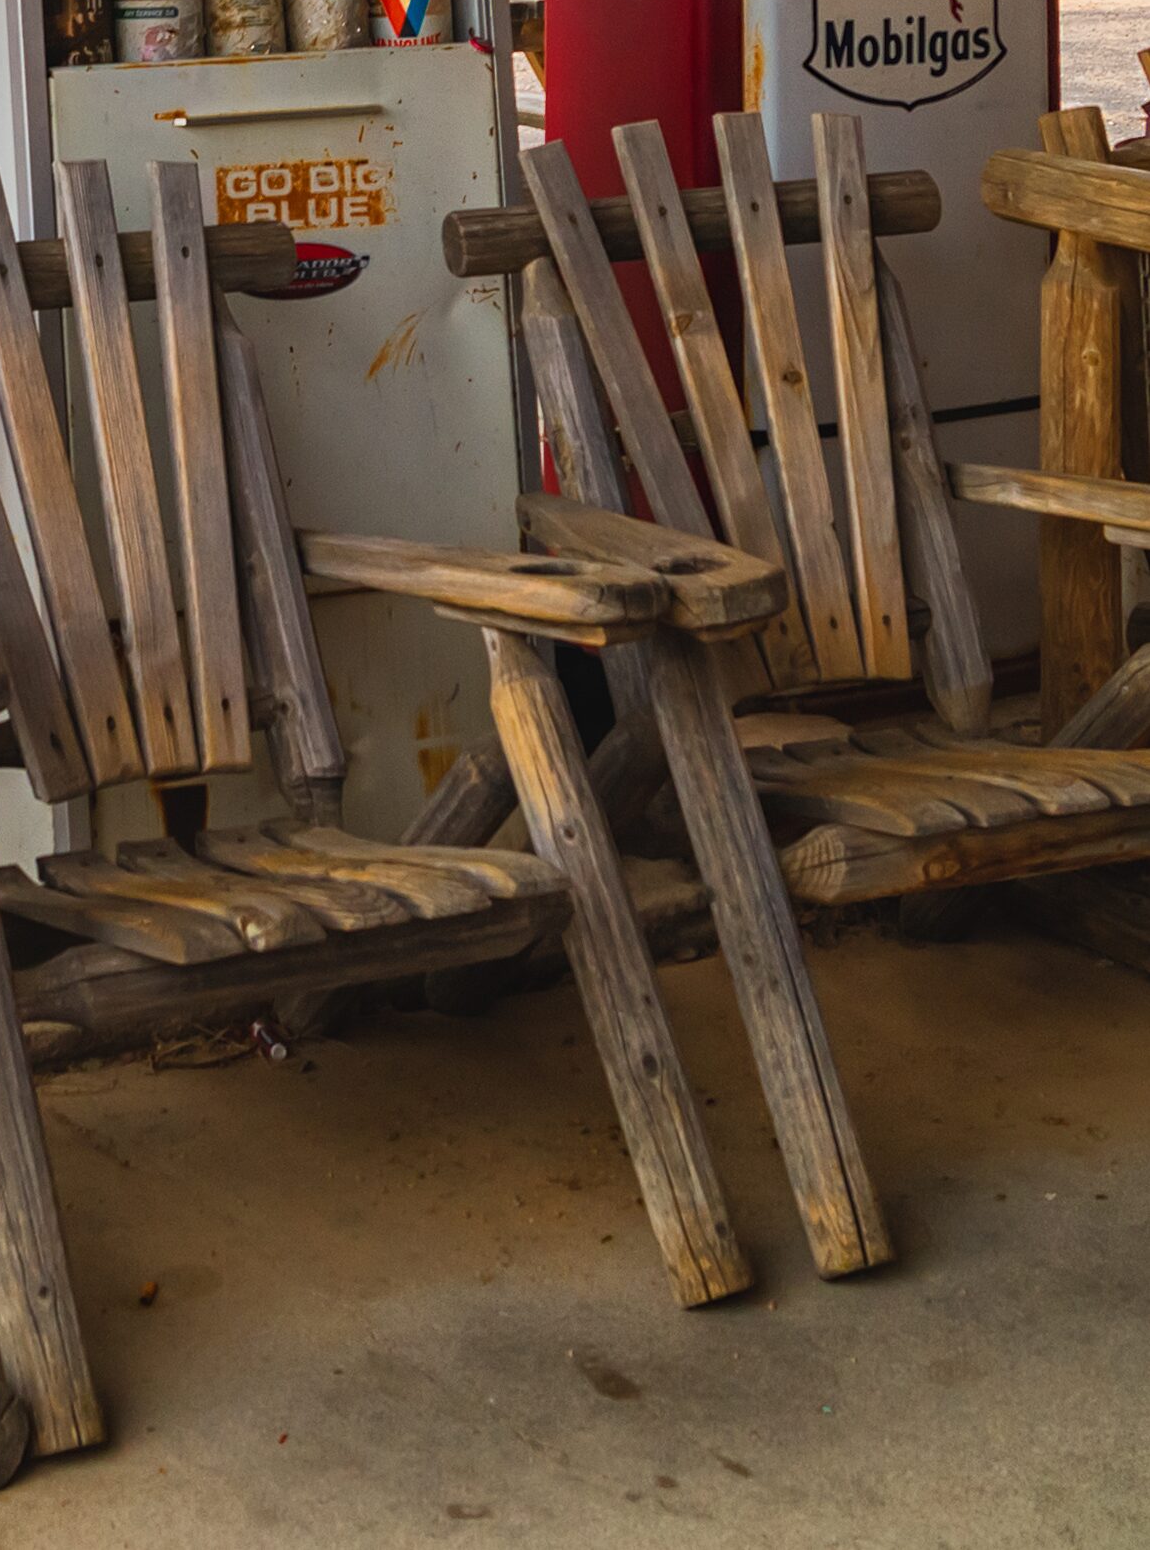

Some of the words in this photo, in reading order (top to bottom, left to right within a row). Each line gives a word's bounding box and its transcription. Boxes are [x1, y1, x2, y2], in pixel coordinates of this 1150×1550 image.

[824, 15, 991, 78] Mobilgas
[225, 168, 293, 200] GO
[309, 162, 387, 194] BIG
[245, 195, 370, 226] BLUE
